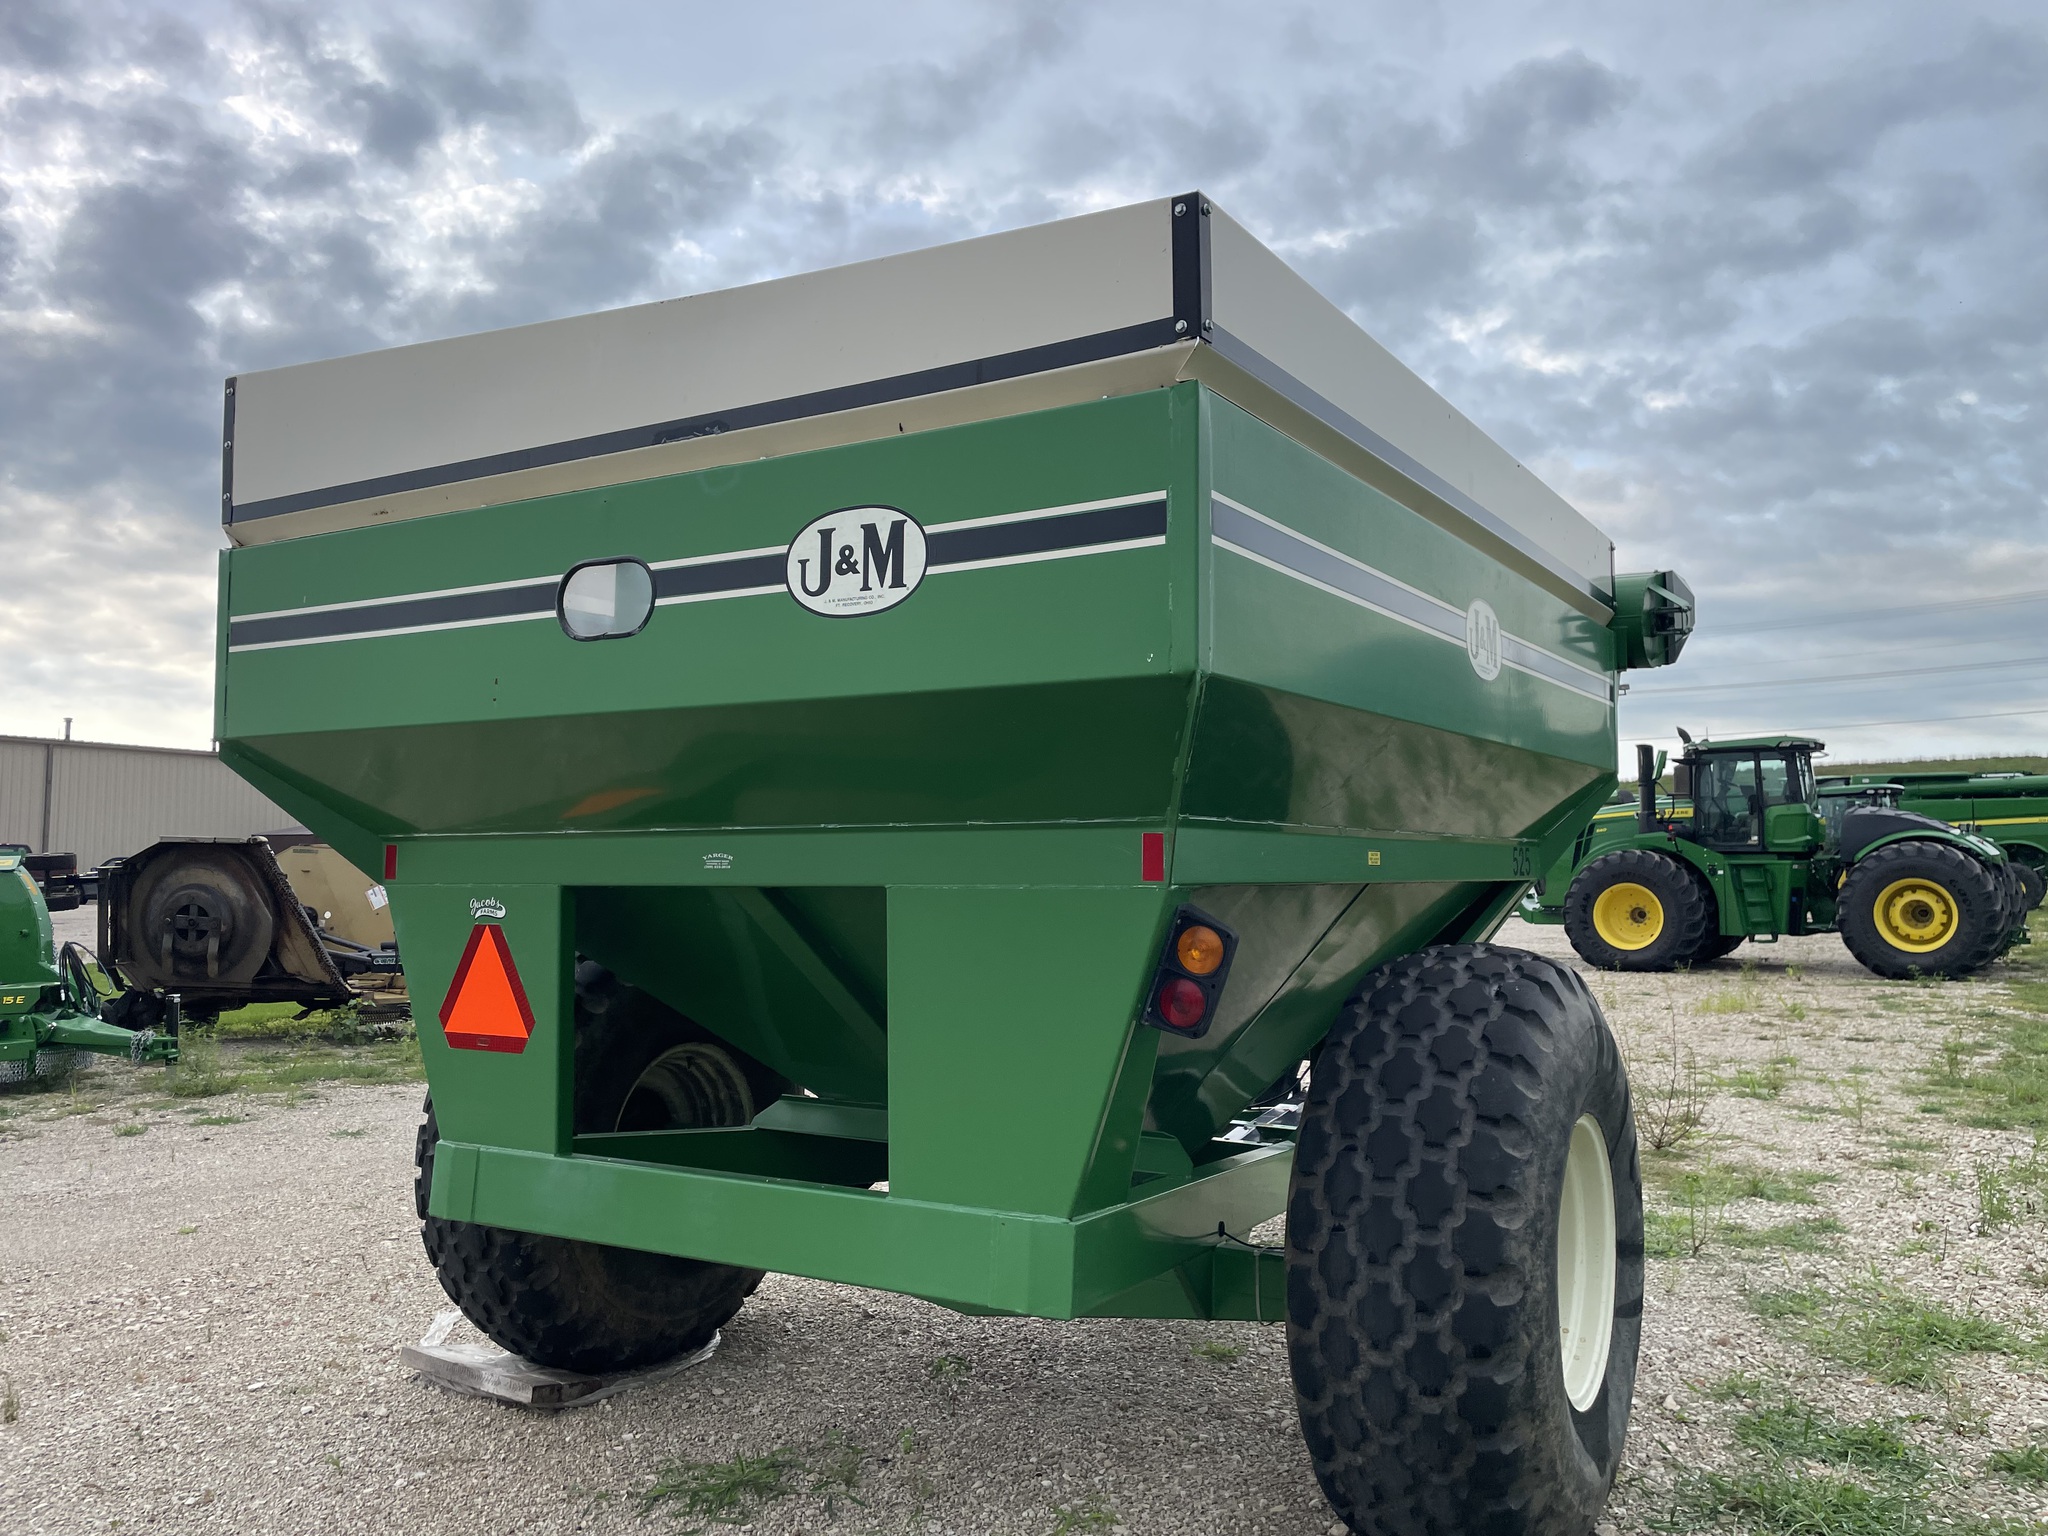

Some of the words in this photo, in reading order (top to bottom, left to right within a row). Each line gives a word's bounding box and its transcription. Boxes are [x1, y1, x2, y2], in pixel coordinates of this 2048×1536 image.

[798, 519, 908, 598] J&M
[1469, 608, 1498, 669] J&M
[702, 852, 734, 861] YARGER
[1513, 846, 1531, 877] 525
[469, 896, 500, 916] Jacobs
[16, 995, 26, 1004] E
